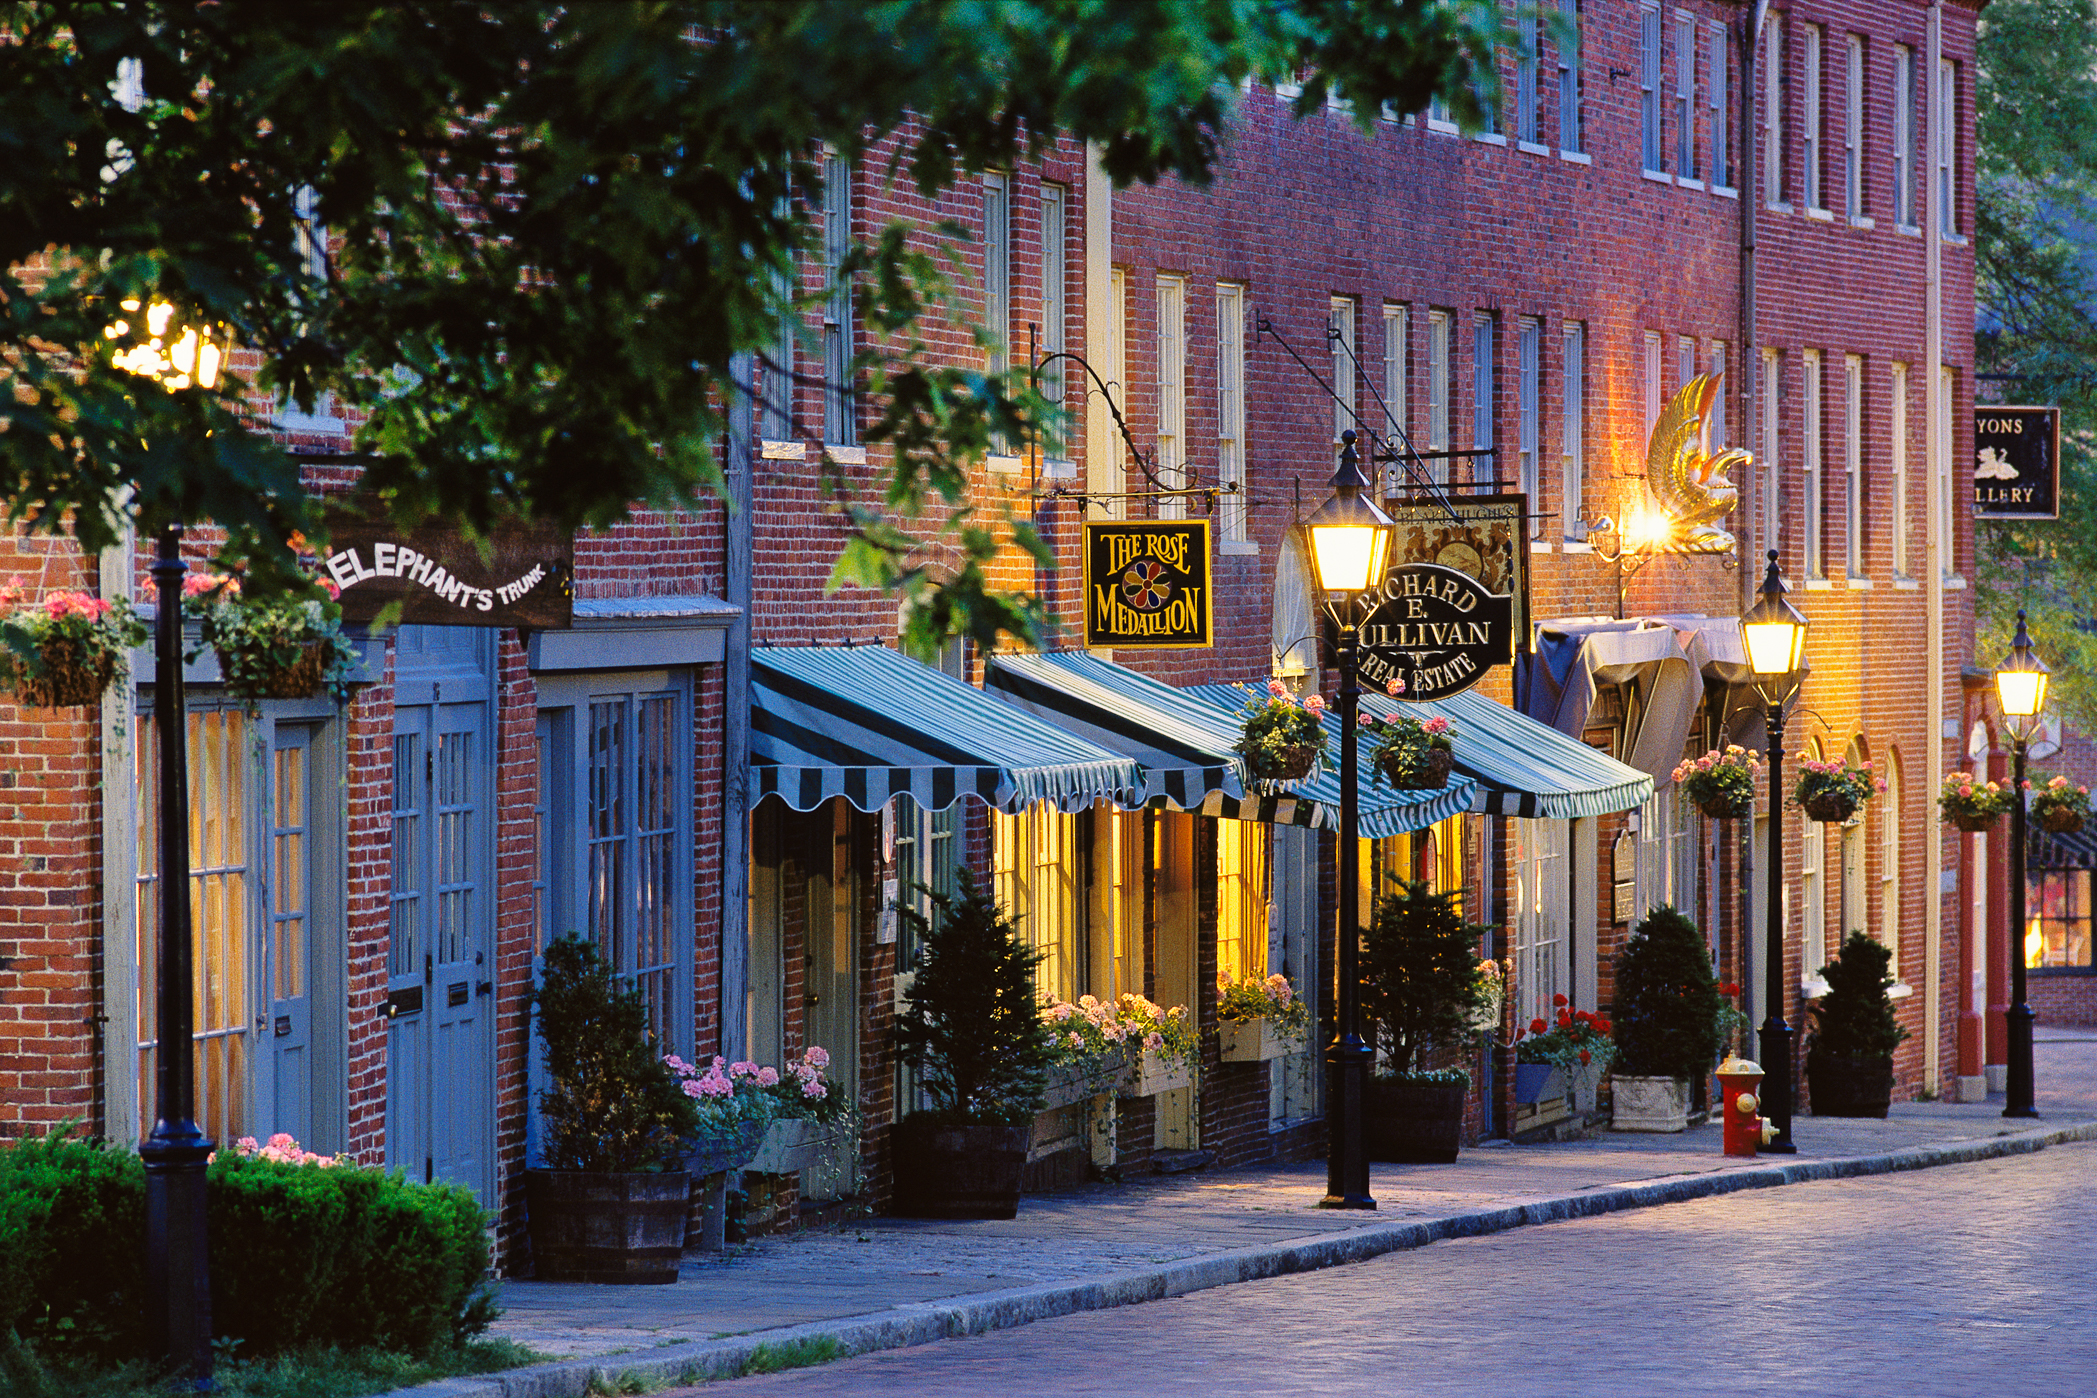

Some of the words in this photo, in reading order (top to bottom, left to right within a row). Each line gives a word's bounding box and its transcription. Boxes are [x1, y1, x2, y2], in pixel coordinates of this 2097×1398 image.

[1976, 418, 2023, 434] YONS
[1975, 487, 2034, 503] LLERY
[1100, 534, 1142, 576] THE
[1144, 533, 1191, 575] ROSE
[325, 542, 493, 612] ELEPHANT'S
[496, 563, 546, 605] TRUNK
[1357, 573, 1478, 613] RICHARD
[1094, 583, 1201, 636] MEDALLION
[1406, 598, 1429, 619] E.
[1358, 621, 1491, 648] ULLIVAN
[1413, 652, 1477, 692] ESTATE
